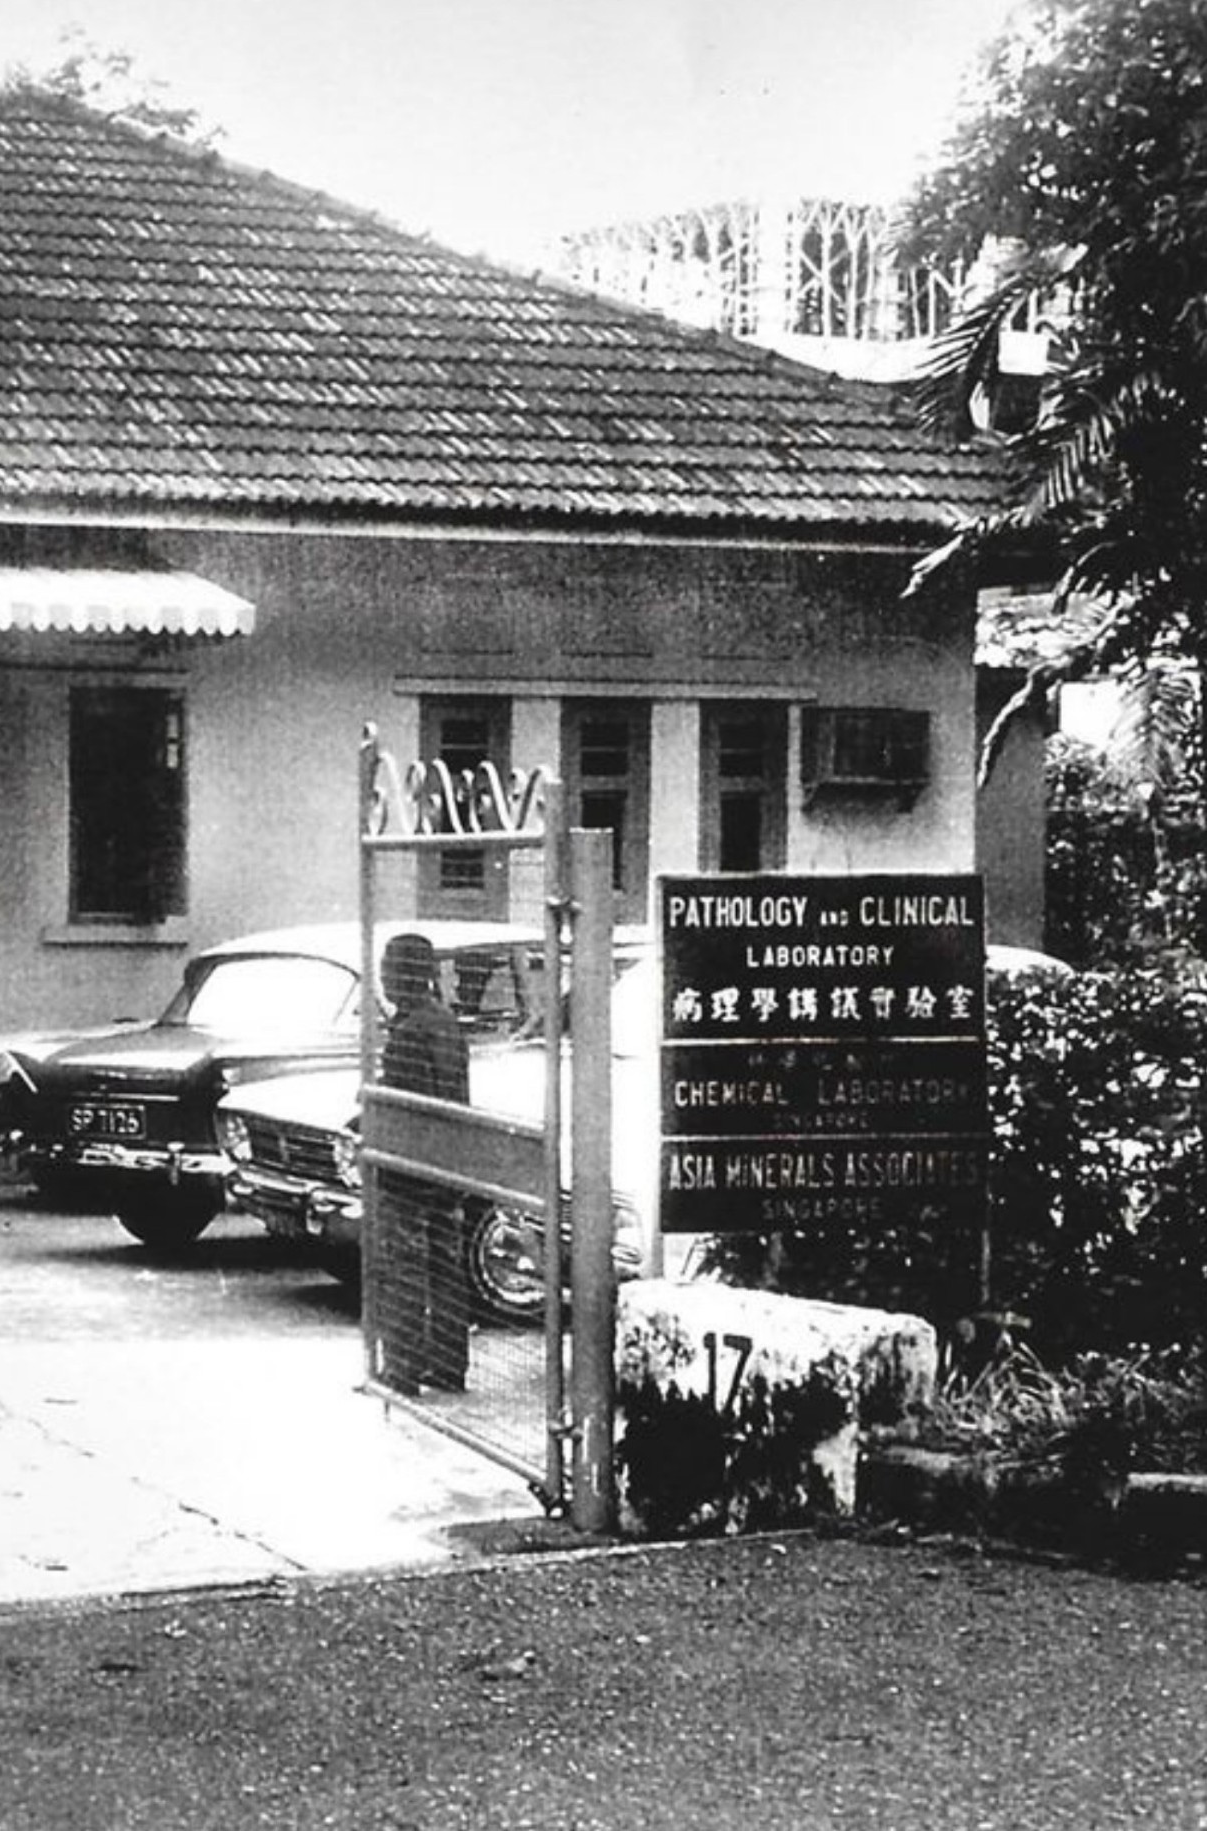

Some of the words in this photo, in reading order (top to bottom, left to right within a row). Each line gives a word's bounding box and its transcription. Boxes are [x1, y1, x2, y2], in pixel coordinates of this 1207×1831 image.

[669, 896, 808, 927] PATHOLOGY
[859, 896, 974, 926] CLINICAL
[746, 945, 894, 967] LABORATORY
[818, 1078, 968, 1105] LABORATOR
[669, 1153, 716, 1190] ASIA
[703, 1331, 753, 1413] 17
